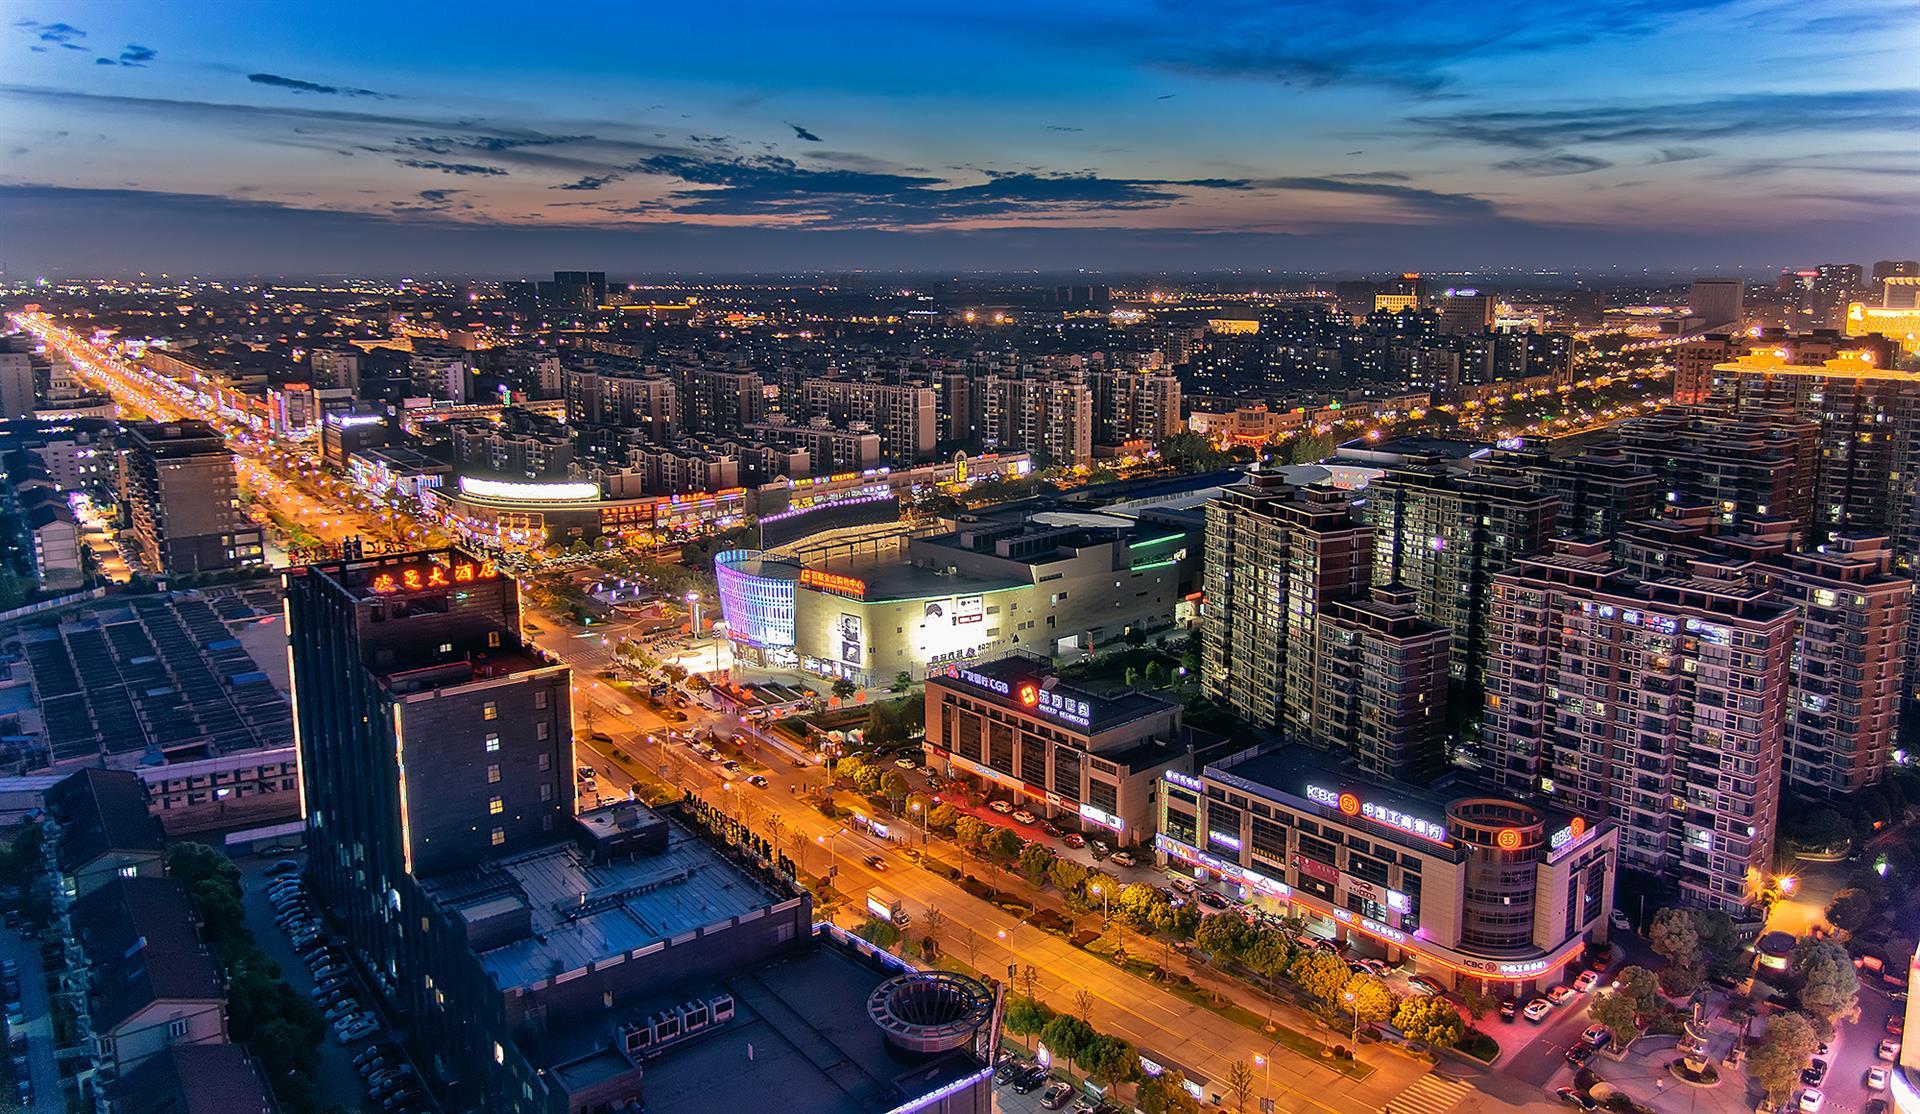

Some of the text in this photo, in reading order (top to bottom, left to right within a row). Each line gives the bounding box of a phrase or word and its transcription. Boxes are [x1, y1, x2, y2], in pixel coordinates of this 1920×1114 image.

[989, 678, 1009, 694] CGB
[1306, 784, 1442, 840] ICBC 中国工商银行
[1463, 959, 1484, 970] ICBC
